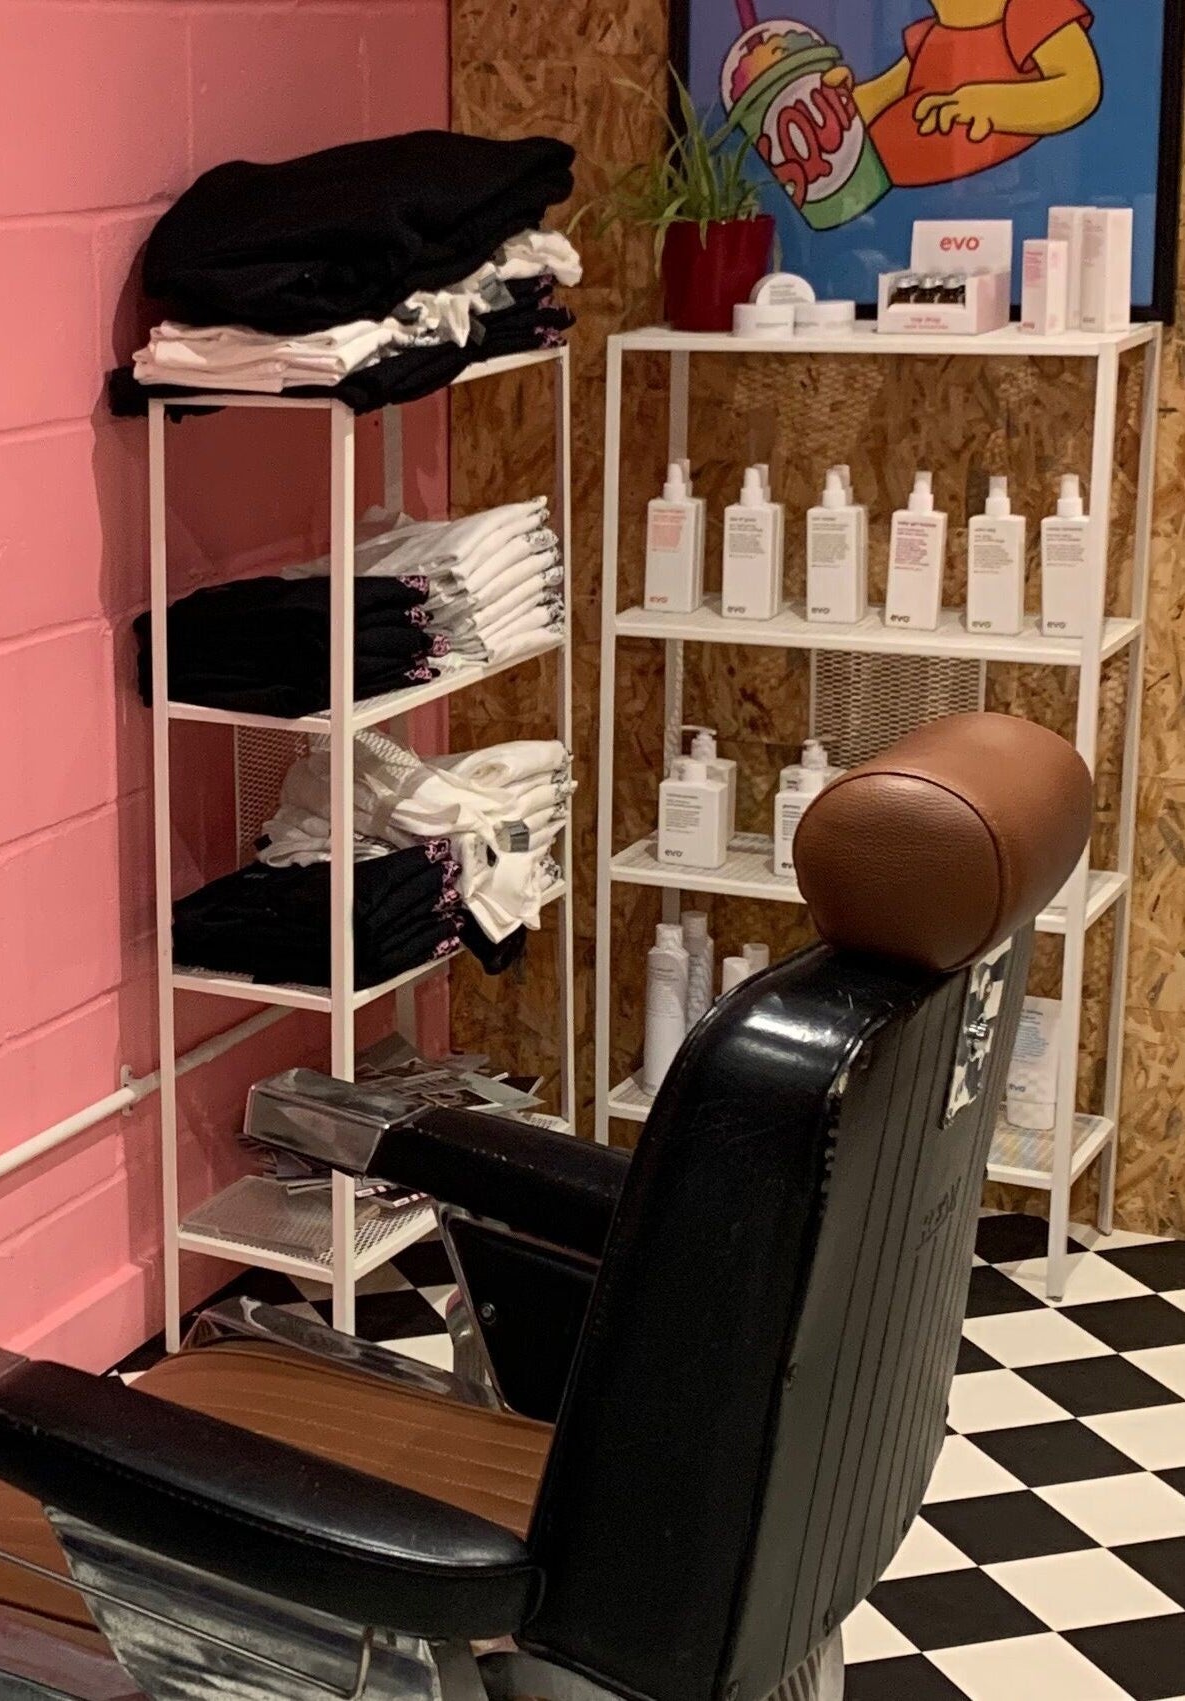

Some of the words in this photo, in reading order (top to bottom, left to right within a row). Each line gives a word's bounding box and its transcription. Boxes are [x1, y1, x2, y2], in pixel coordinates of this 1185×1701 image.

[939, 236, 981, 251] evo
[727, 606, 747, 614] evo
[811, 607, 831, 615] evo
[890, 614, 911, 623] evo
[971, 621, 992, 629] evo
[1047, 621, 1067, 629] evo
[664, 849, 683, 858] evo
